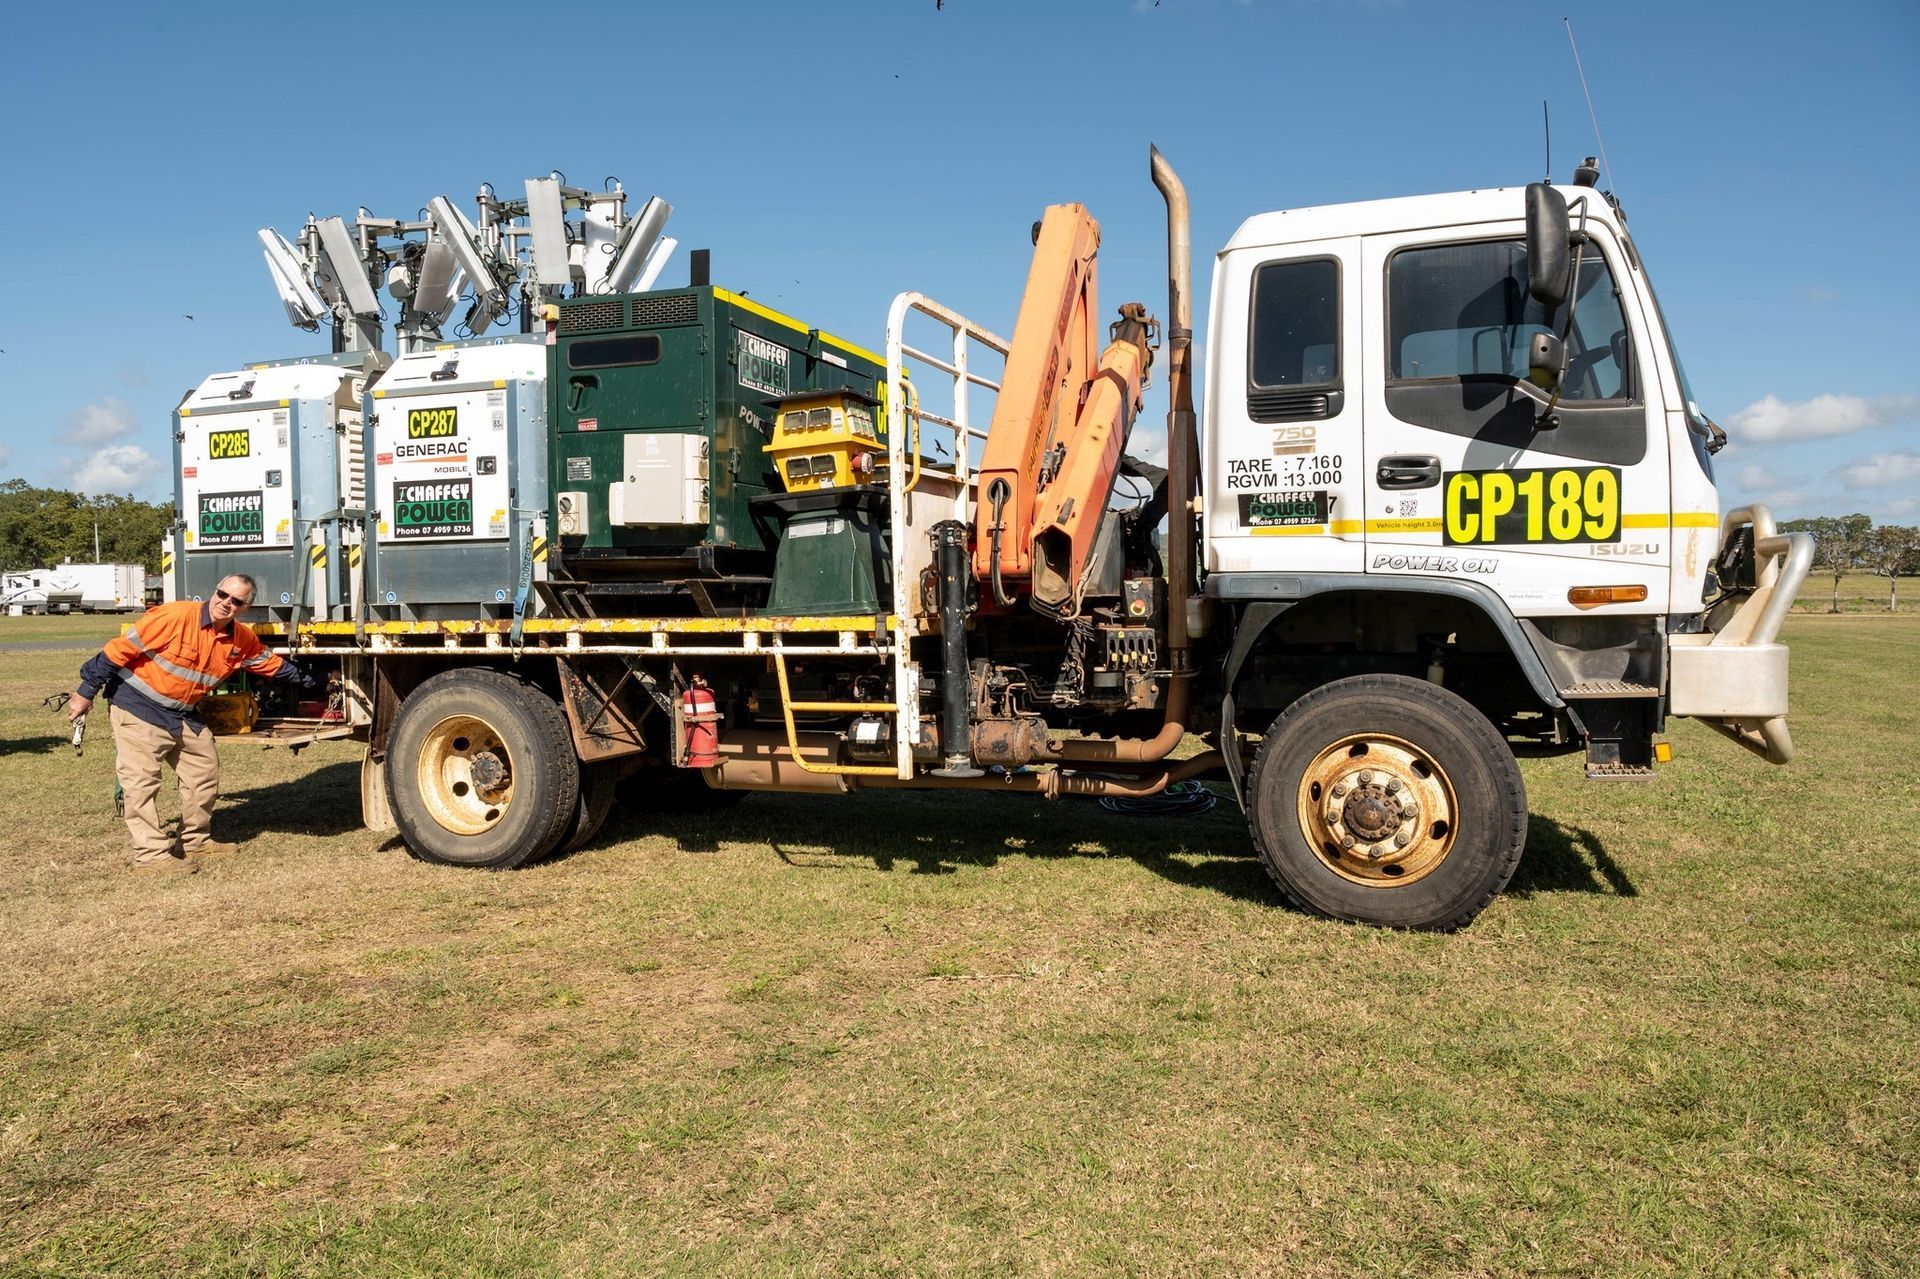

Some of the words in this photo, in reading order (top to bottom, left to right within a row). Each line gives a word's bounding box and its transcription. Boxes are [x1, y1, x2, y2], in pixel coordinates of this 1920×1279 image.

[742, 353, 787, 390] POWER
[410, 410, 456, 437] CP287
[1272, 426, 1316, 441] 750
[210, 432, 249, 458] CP285
[396, 442, 468, 457] GENERAC
[434, 466, 468, 474] MOBILE
[1228, 458, 1272, 473] TARE
[1228, 473, 1277, 488] RGVM
[397, 502, 470, 524] POWER
[1250, 502, 1316, 517] POWER
[1446, 469, 1618, 544] CP189
[201, 511, 262, 533] POWER
[1376, 521, 1401, 529] Vehicle
[1402, 521, 1425, 530] height
[396, 527, 420, 535] Phone
[433, 526, 451, 534] 4959
[453, 525, 471, 533] 5736
[200, 536, 220, 544] Phone
[1589, 543, 1660, 556] ISUZU
[1372, 554, 1458, 573] POWER
[1462, 558, 1499, 574] ON
